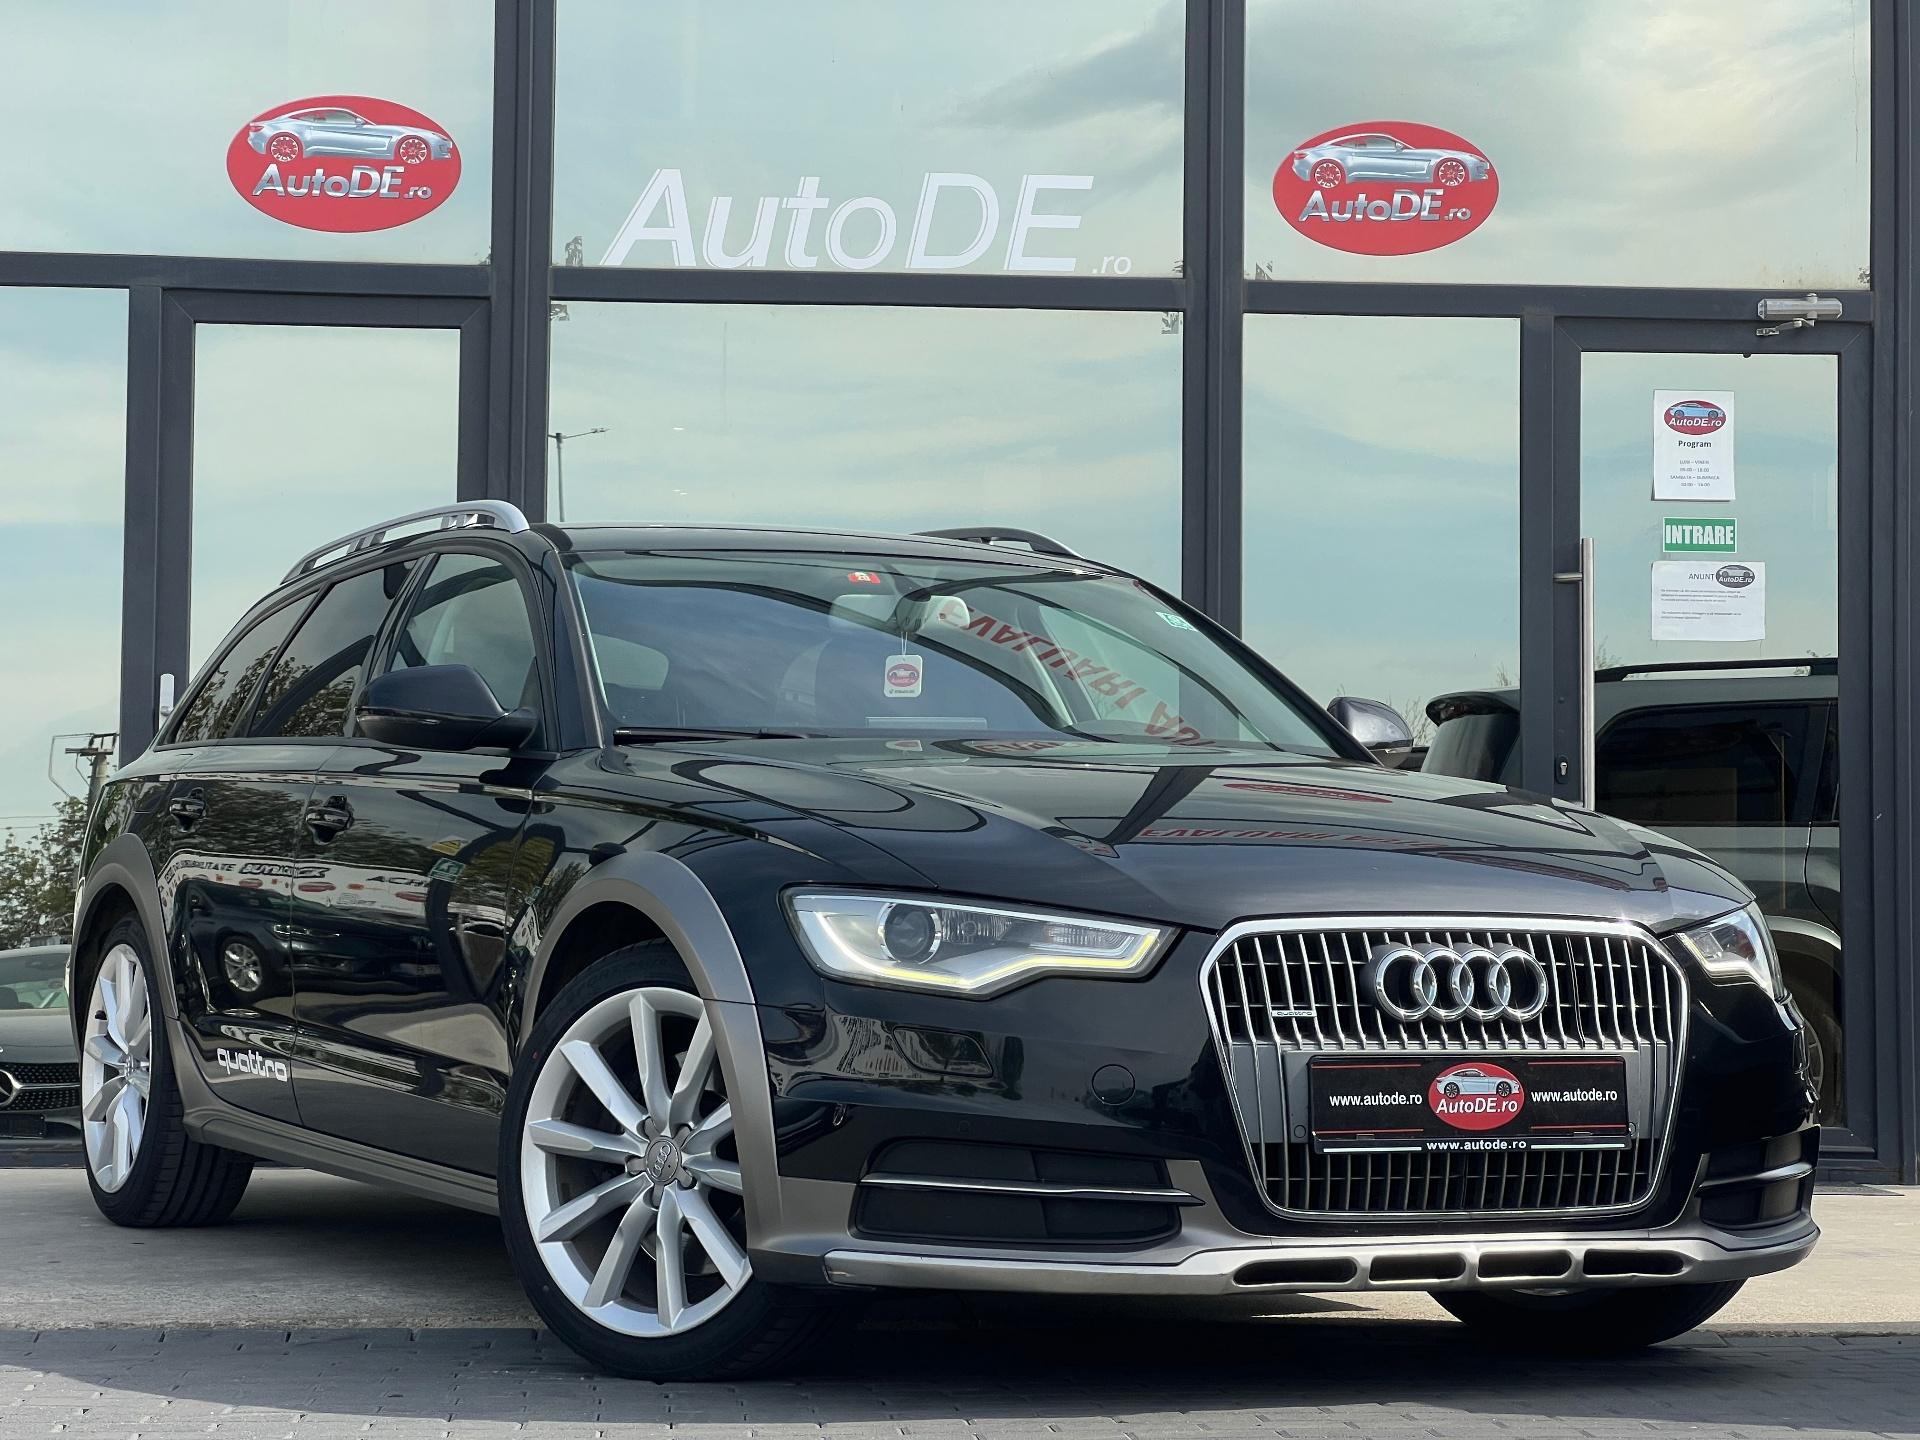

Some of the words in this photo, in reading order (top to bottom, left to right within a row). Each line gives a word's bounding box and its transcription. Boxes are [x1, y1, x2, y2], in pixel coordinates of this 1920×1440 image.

[1668, 418, 1722, 427] AutoDE.ro
[1678, 440, 1712, 448] Program
[1665, 525, 1734, 544] INTRARE
[217, 1048, 288, 1082] quattro
[1329, 1091, 1423, 1107] www.autode.ro
[1531, 1087, 1618, 1103] www.autode.ro
[1435, 1097, 1518, 1114] AutoDE.ro
[1426, 1139, 1527, 1151] www.autode.ro
